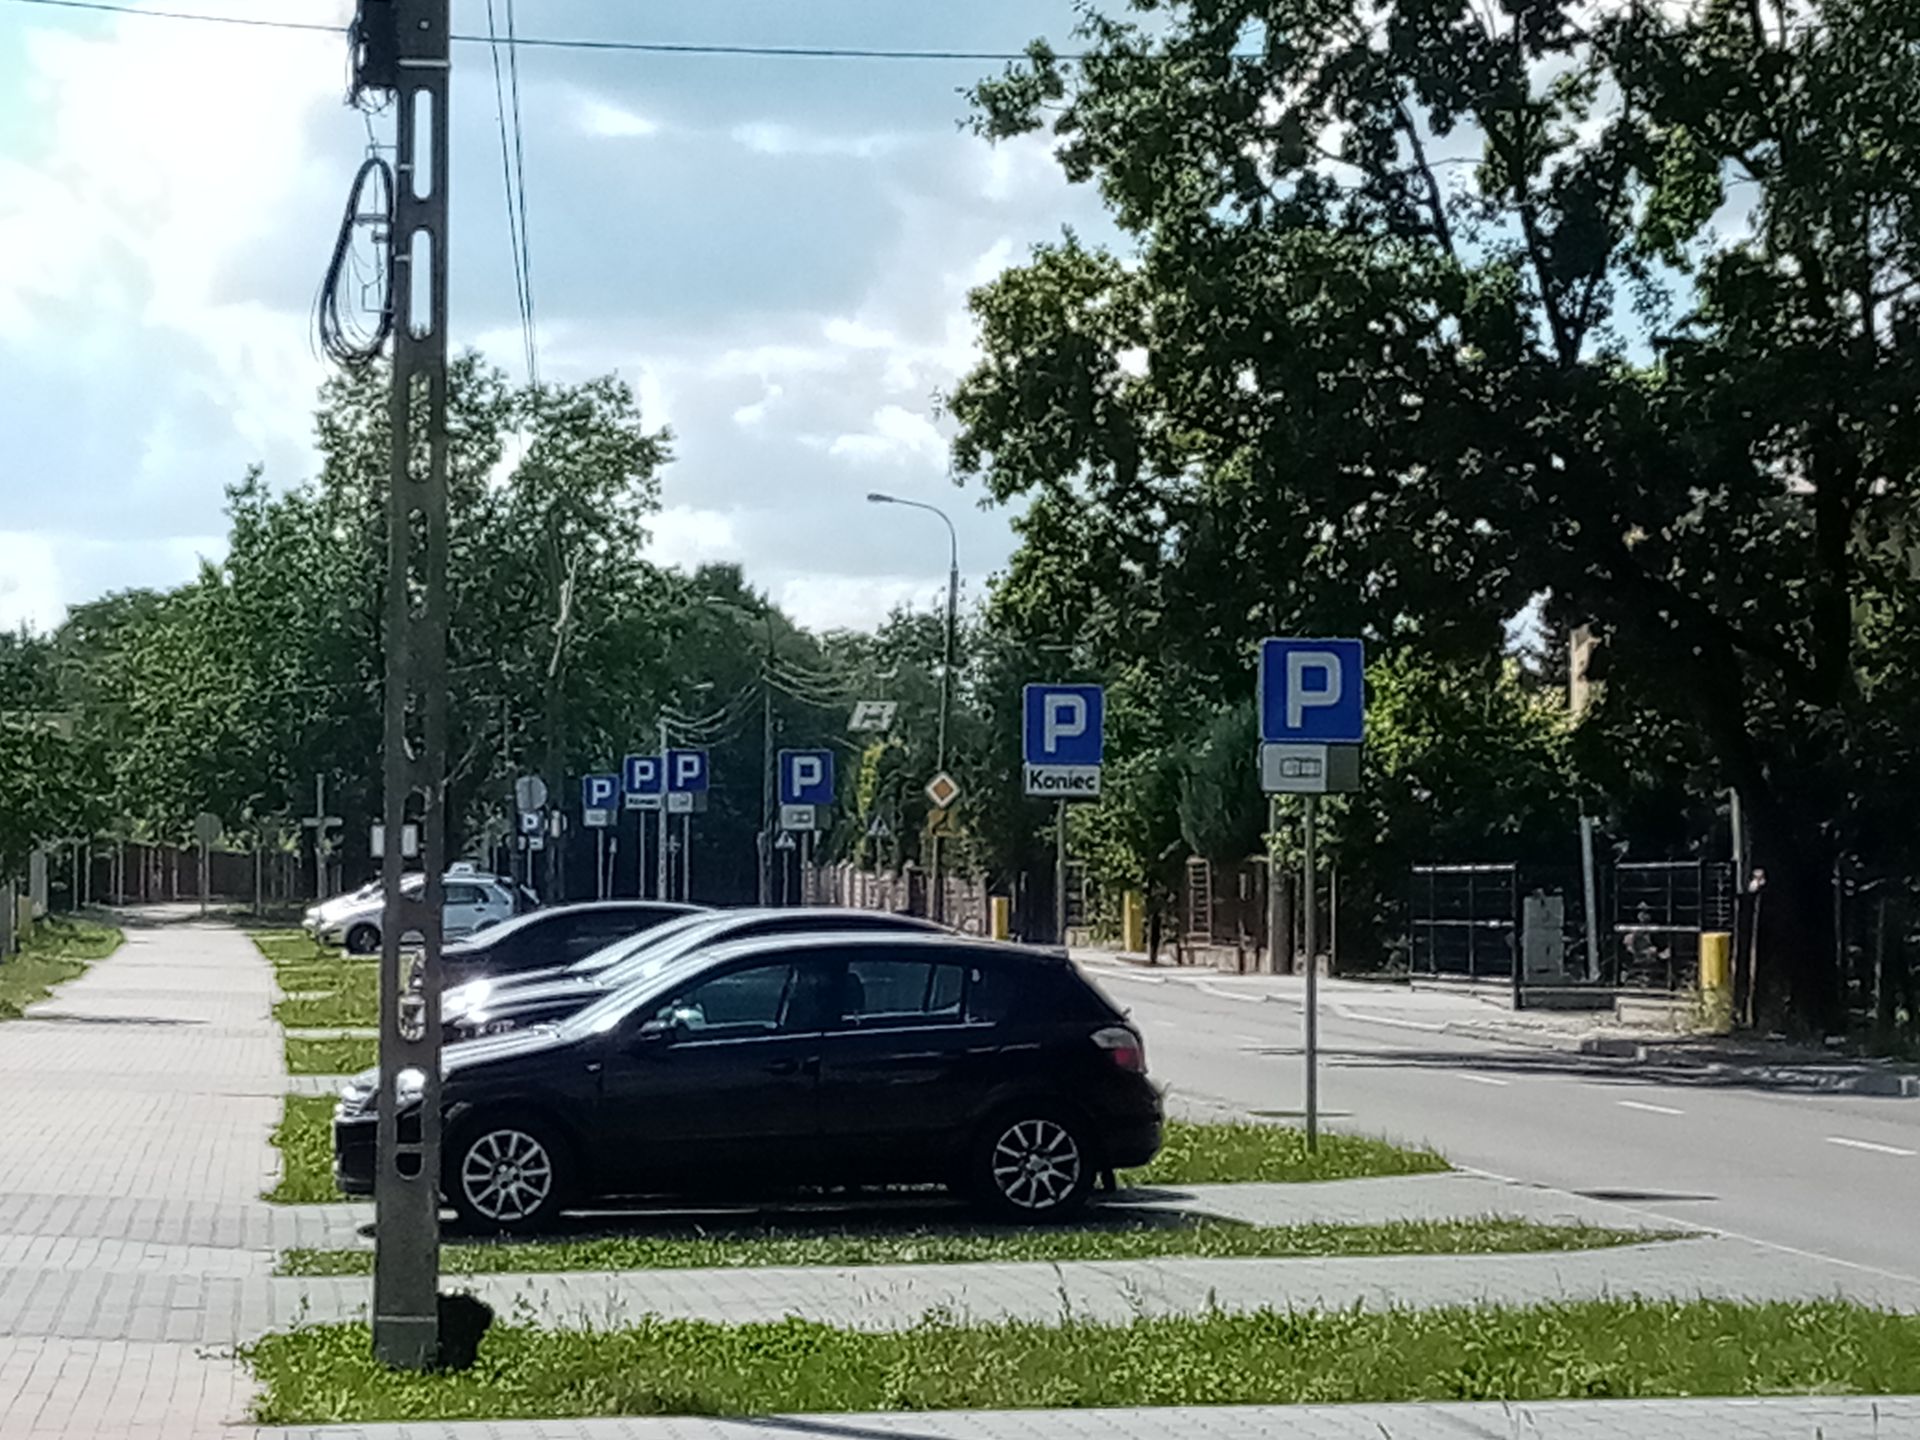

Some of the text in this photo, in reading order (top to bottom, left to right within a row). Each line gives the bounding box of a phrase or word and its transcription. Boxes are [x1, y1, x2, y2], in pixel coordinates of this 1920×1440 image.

[1287, 651, 1342, 729] P
[1044, 694, 1087, 753] P
[634, 760, 654, 789] P
[677, 755, 701, 787] P
[792, 756, 822, 797] P
[1030, 769, 1095, 790] Koniec
[592, 779, 611, 806] P
